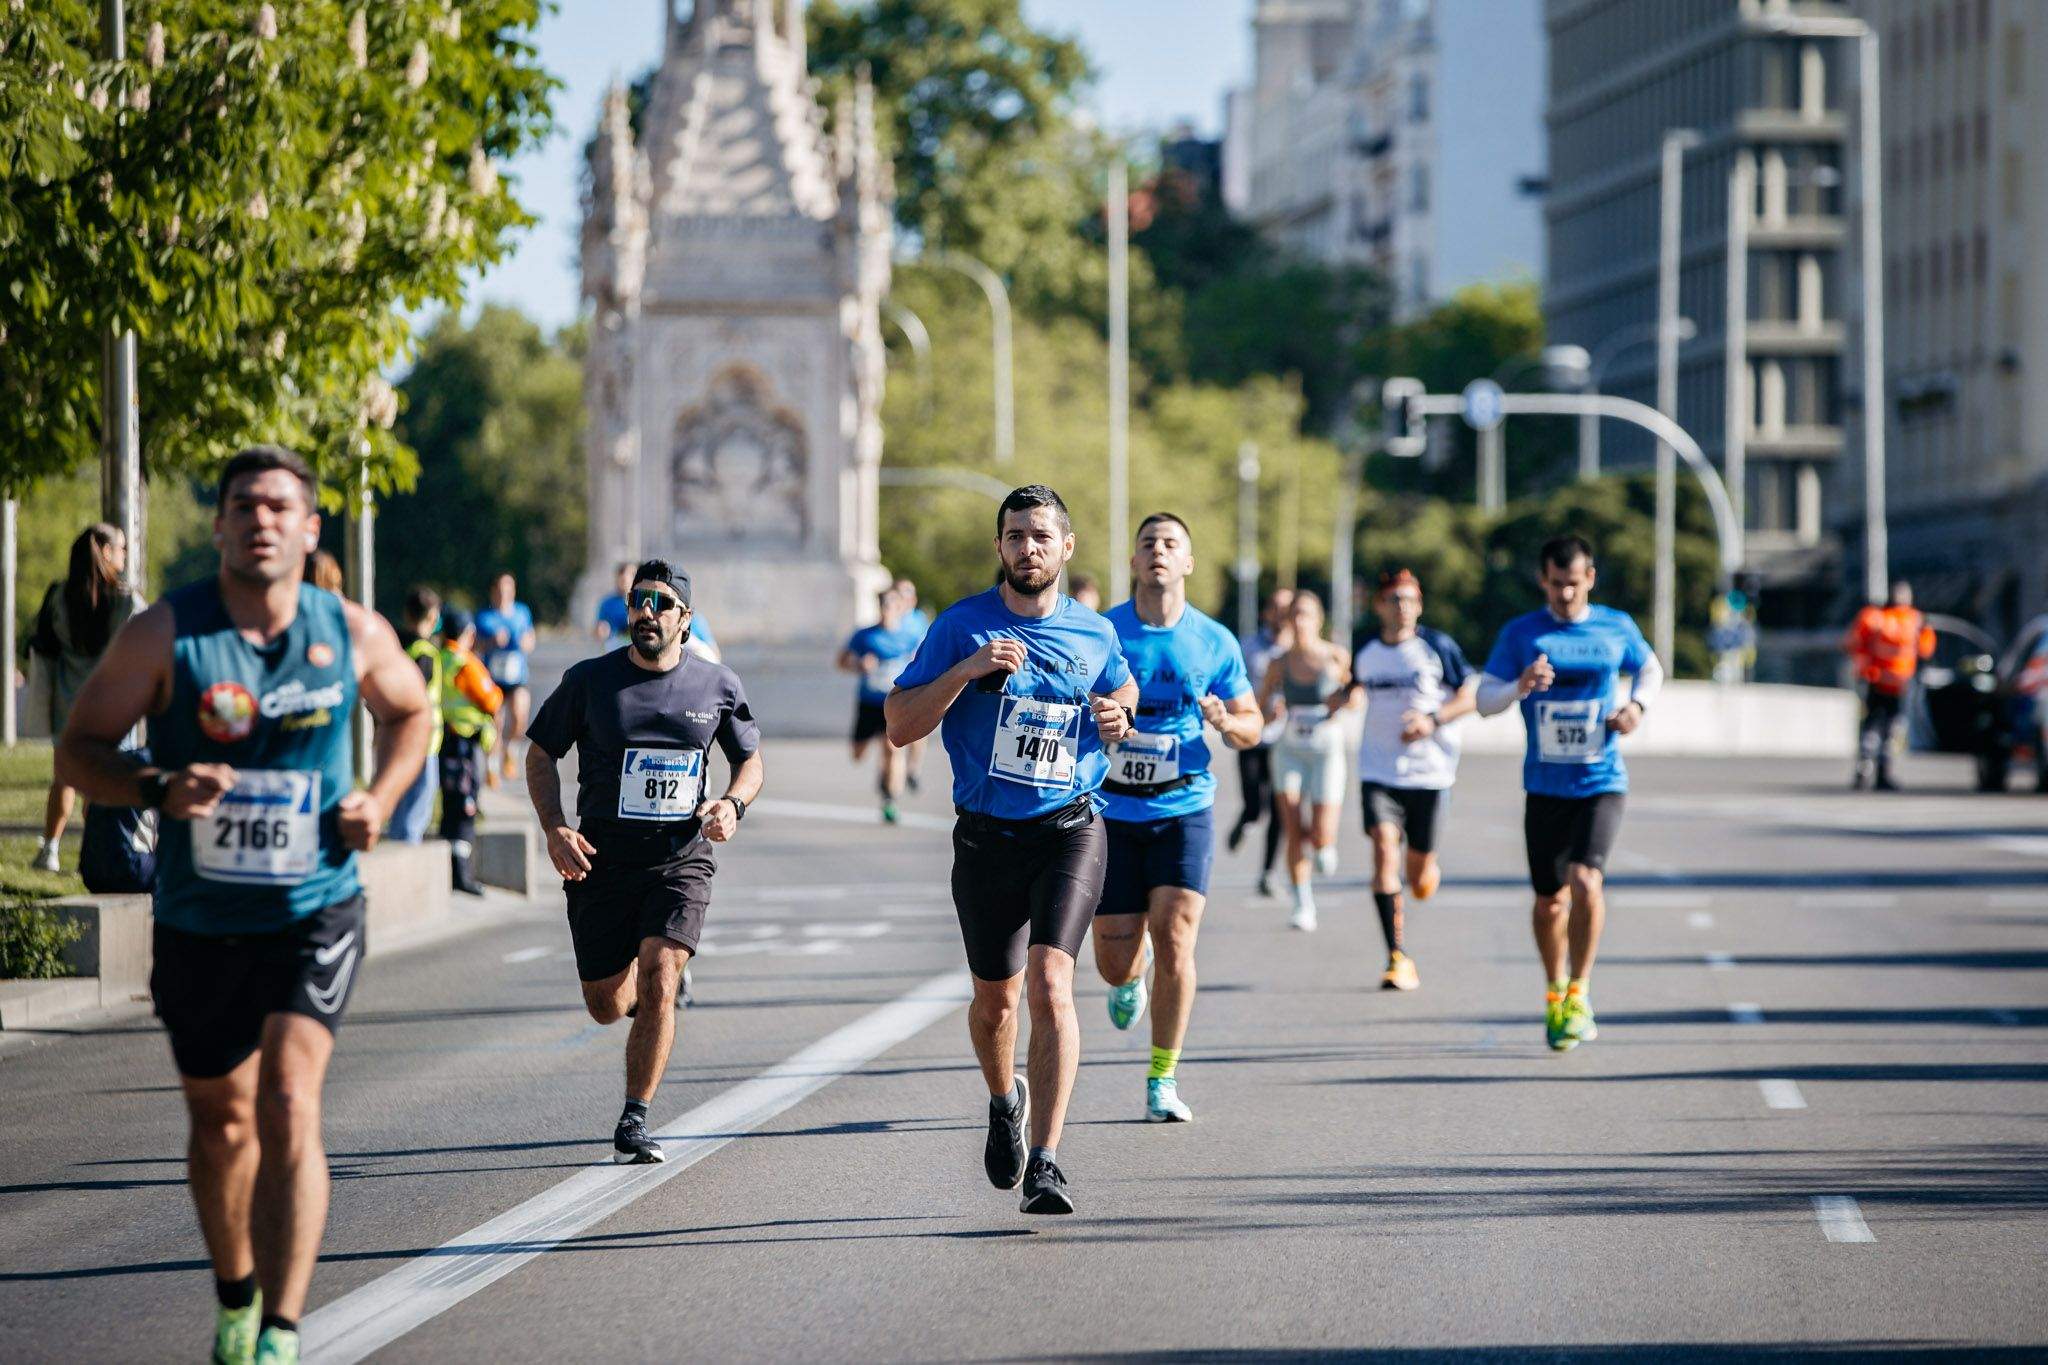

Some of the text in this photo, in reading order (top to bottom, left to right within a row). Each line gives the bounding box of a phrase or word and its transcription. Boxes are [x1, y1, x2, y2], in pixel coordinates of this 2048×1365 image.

[1557, 727, 1587, 744] 573
[1015, 734, 1059, 764] 1470
[1122, 760, 1156, 781] 487
[644, 778, 679, 800] 812
[215, 817, 289, 849] 2166
